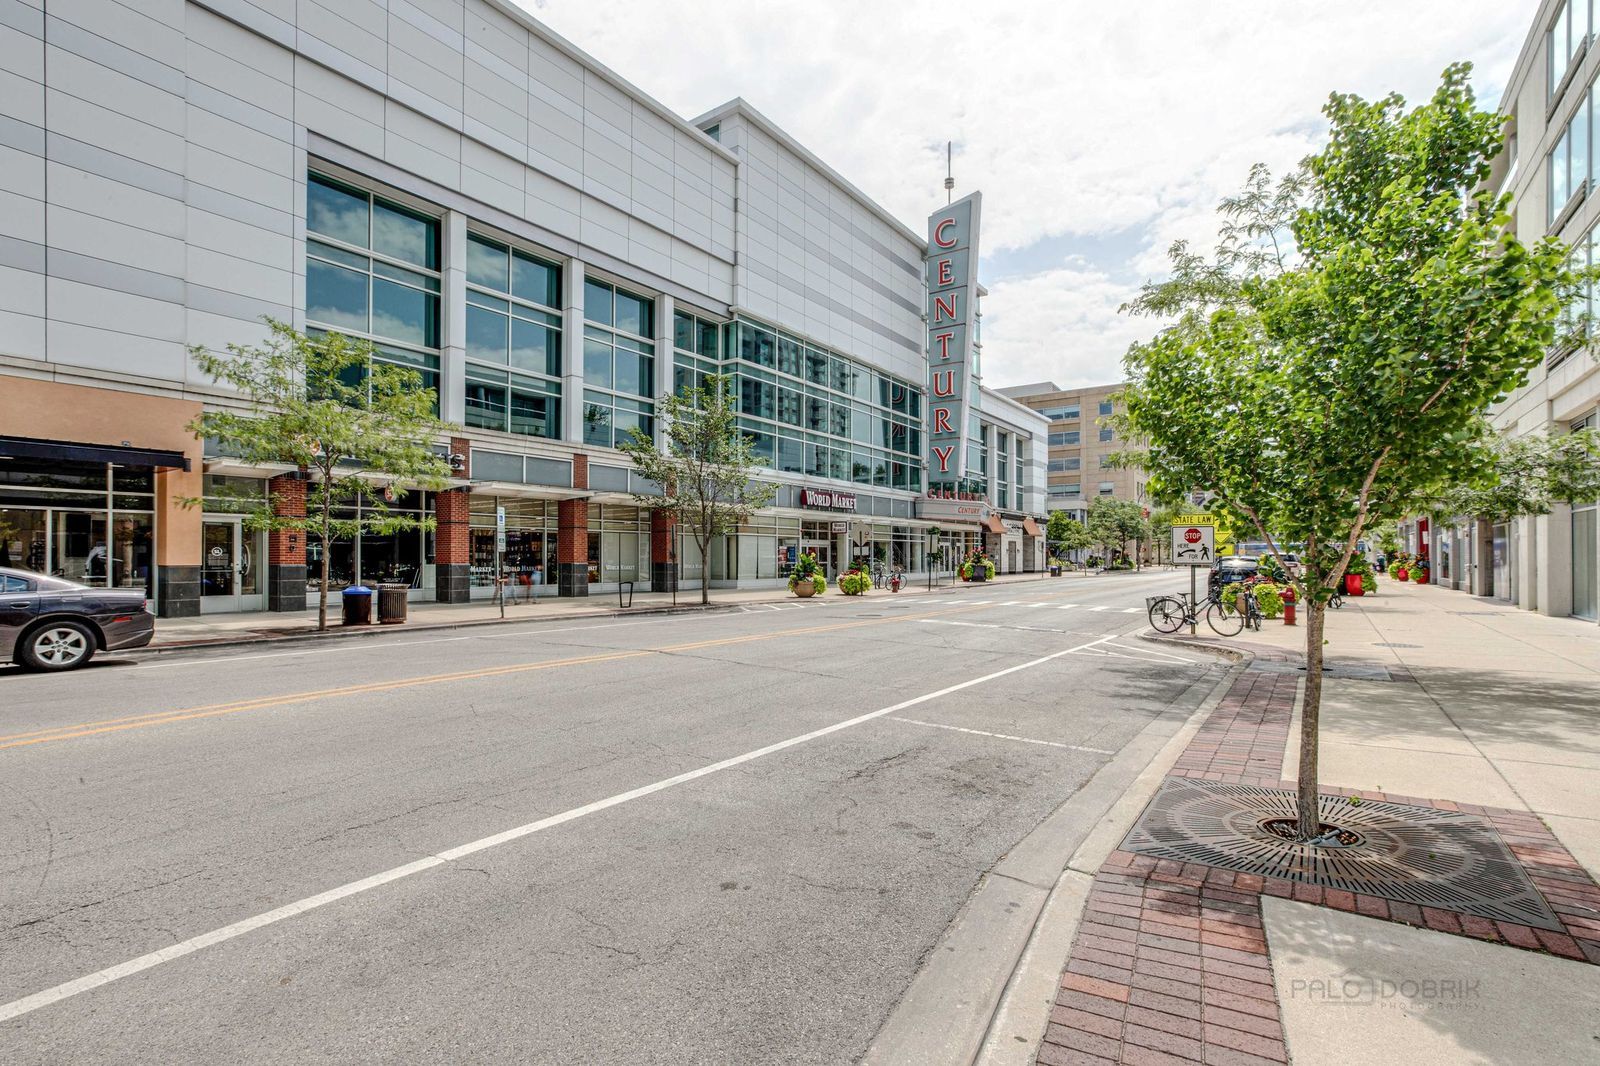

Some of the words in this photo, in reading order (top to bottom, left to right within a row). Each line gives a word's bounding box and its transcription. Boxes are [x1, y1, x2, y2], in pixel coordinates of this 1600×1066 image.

[933, 218, 957, 472] CENTURY
[806, 490, 831, 506] WORLD
[832, 494, 857, 509] MARKET
[958, 506, 980, 514] CENTURY
